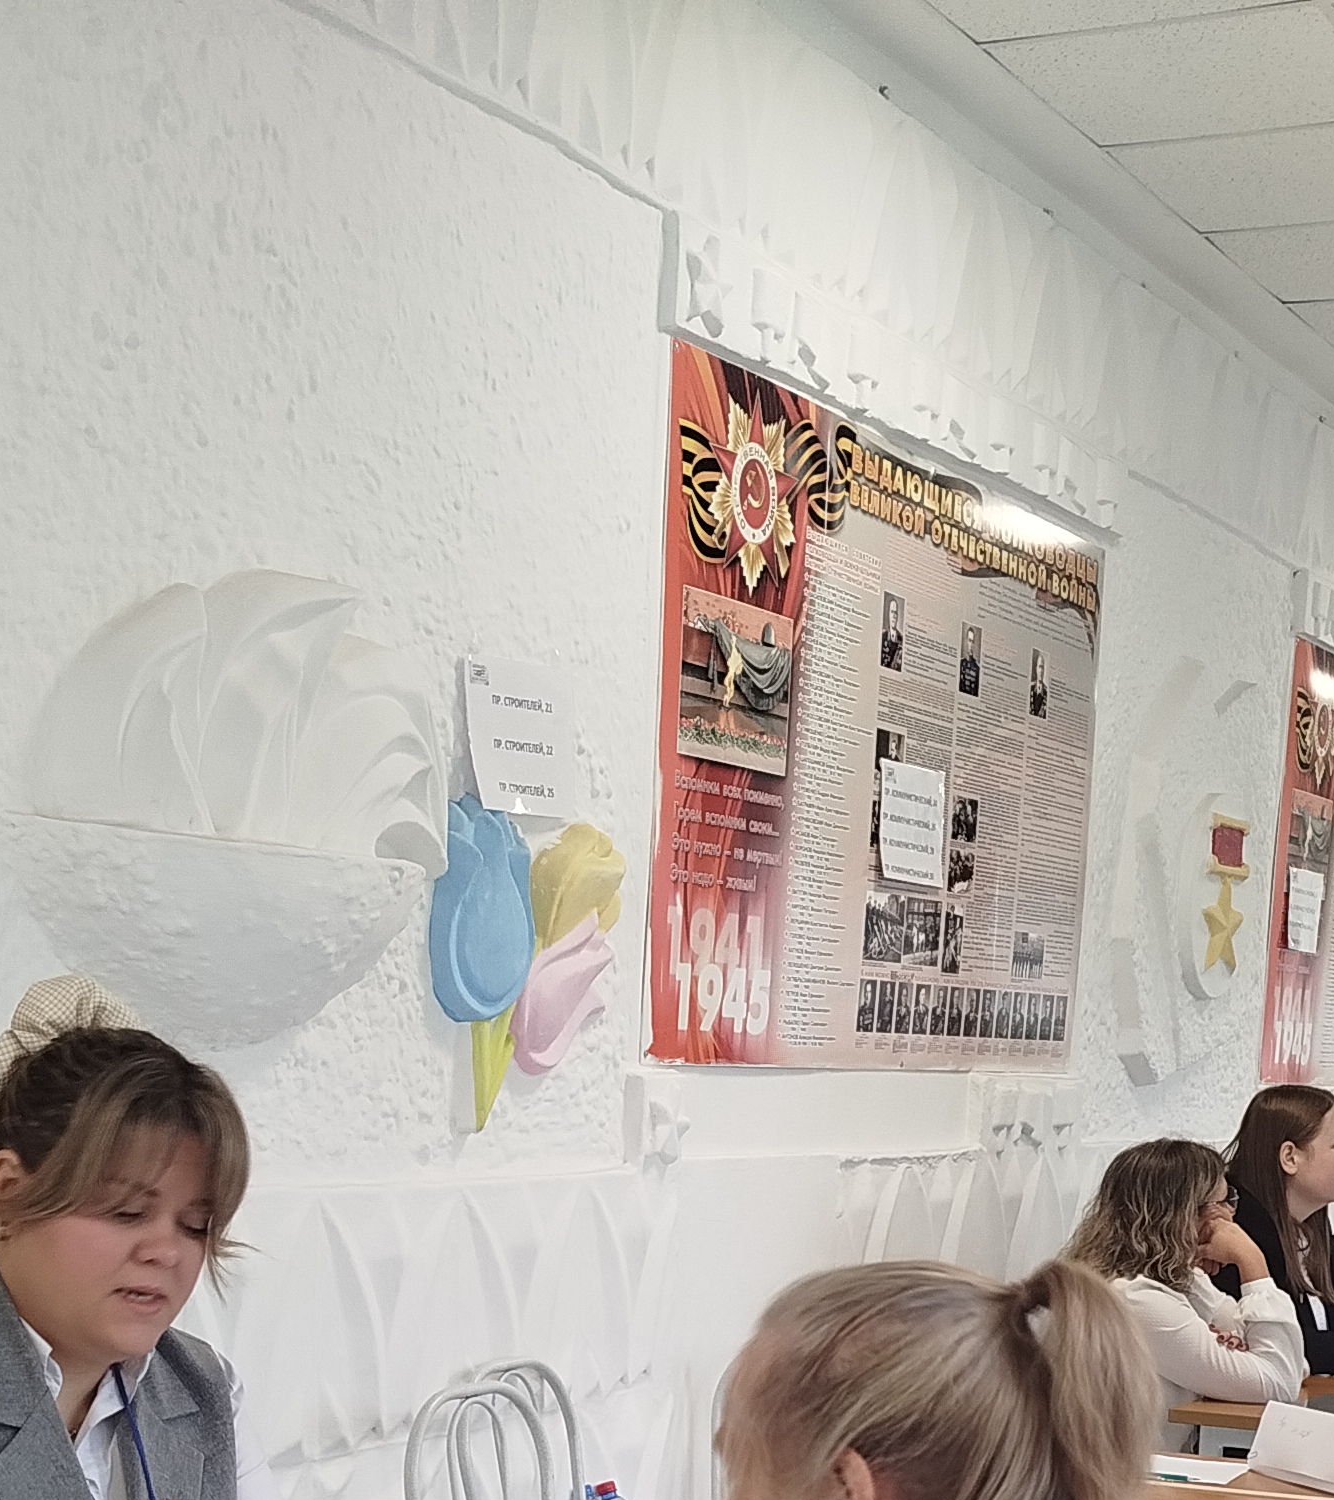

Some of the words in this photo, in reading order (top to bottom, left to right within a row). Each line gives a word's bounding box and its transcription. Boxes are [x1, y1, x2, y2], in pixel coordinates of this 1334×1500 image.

[851, 443, 983, 533] ВЫДАЮЩИЕСЯ
[849, 479, 926, 538] ВЕЛИКОЙ
[930, 518, 1047, 593] ОТЕЧЕСТВЕННОЙ
[1051, 571, 1097, 613] ВОЙНЫ
[492, 694, 503, 705] ПР.
[493, 738, 504, 749] ПР.
[667, 905, 765, 979] 1941
[676, 962, 772, 1036] 1945
